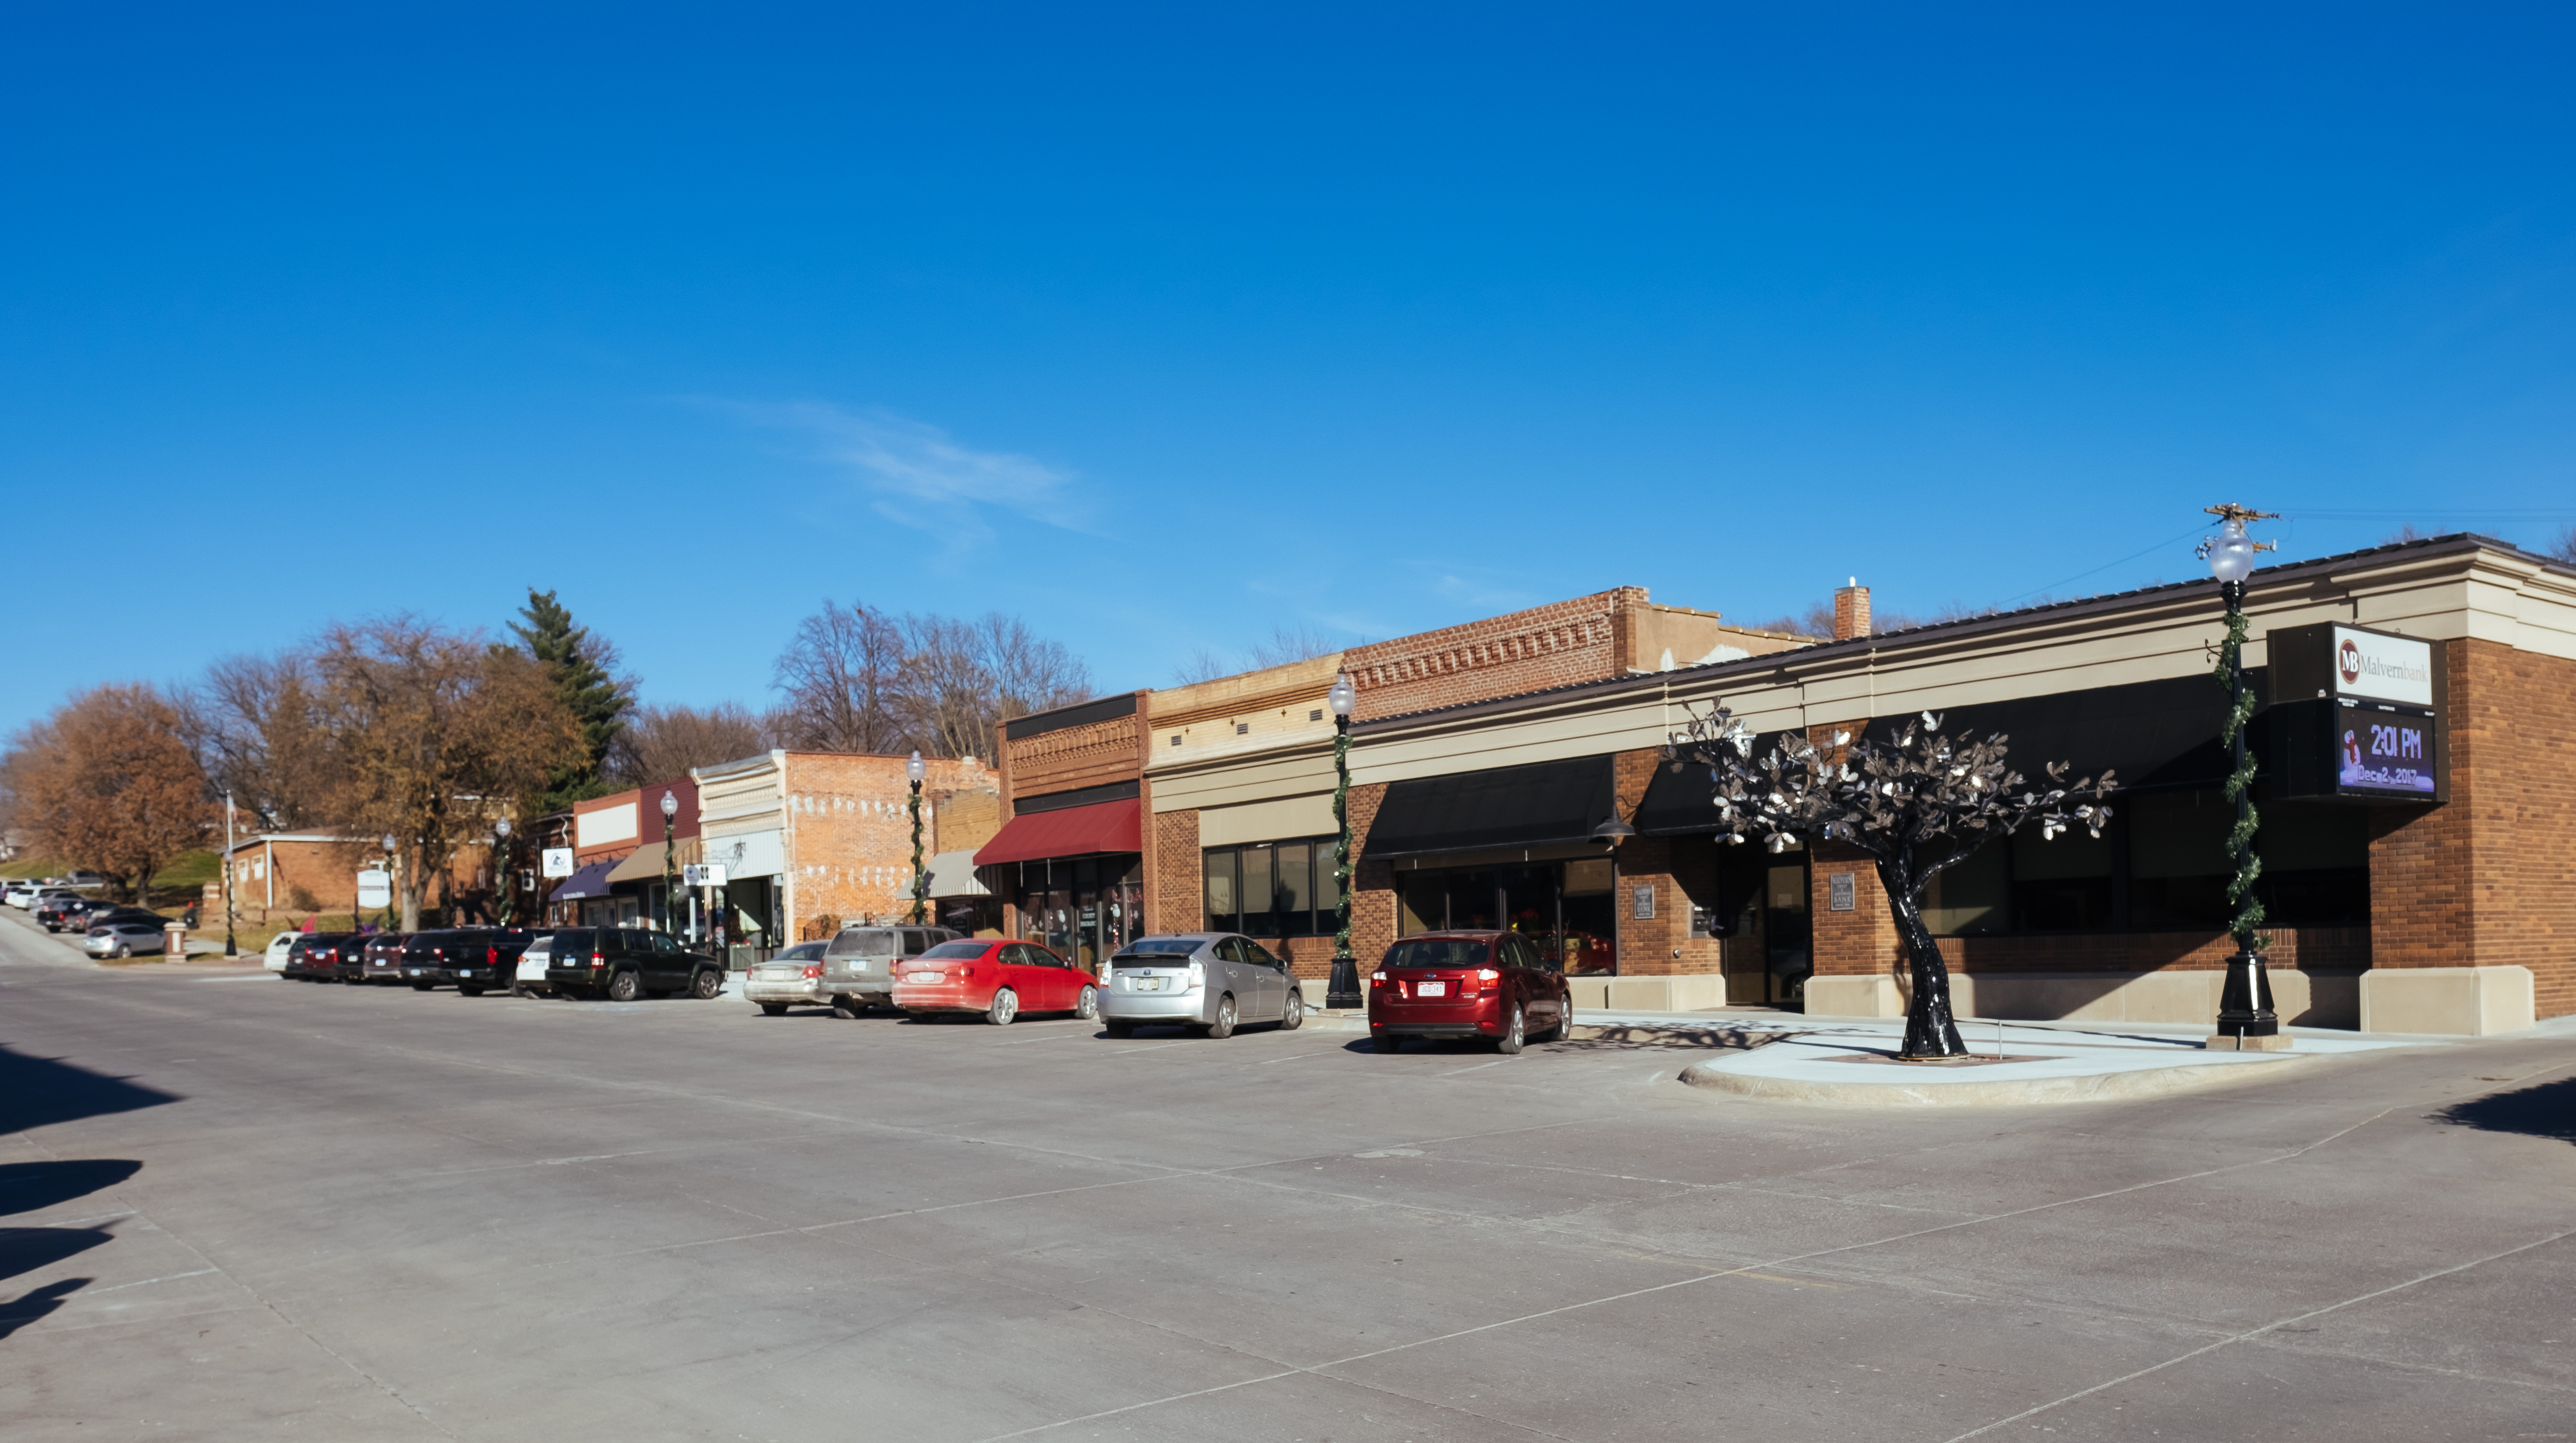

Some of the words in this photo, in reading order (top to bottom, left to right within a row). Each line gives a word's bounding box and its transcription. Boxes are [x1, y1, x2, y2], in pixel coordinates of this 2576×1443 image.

[2342, 650, 2359, 672] MB
[2371, 724, 2398, 757] 2:01
[2401, 728, 2421, 759] PM
[2395, 768, 2417, 784] 2017
